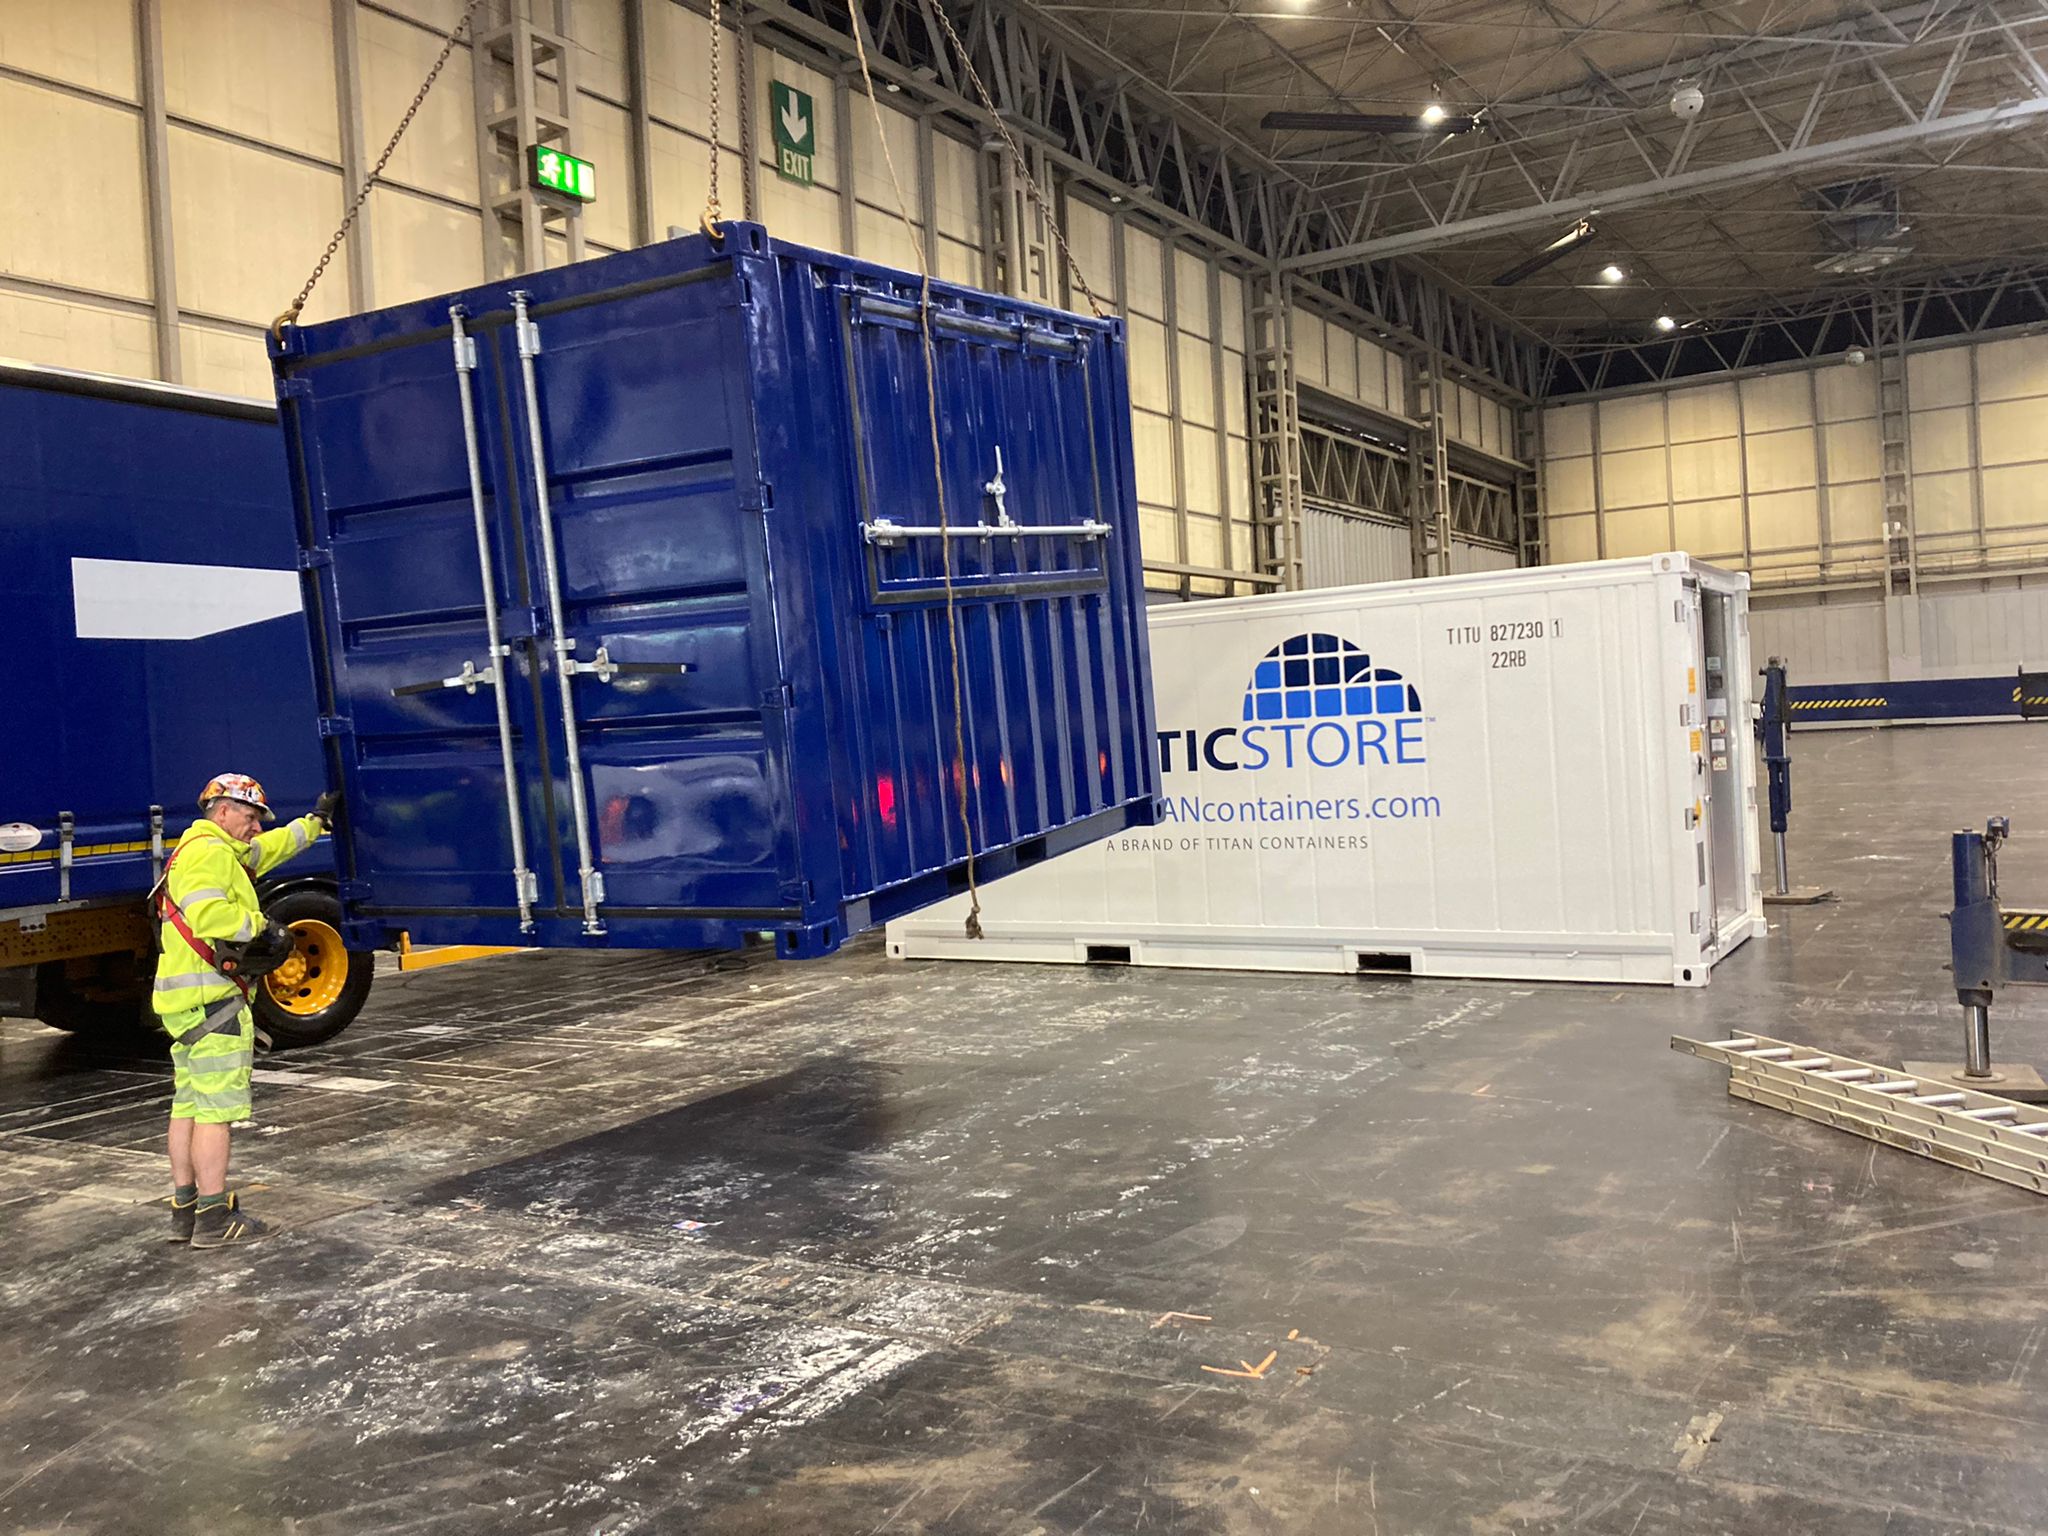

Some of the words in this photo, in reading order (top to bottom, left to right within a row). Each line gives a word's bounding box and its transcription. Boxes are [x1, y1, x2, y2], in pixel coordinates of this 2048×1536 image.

[783, 148, 809, 180] EXIT
[1447, 627, 1481, 645] TITU
[1490, 621, 1543, 642] 827230
[1553, 619, 1561, 637] 1
[1491, 650, 1527, 668] 22RB
[1106, 840, 1115, 851] A
[1122, 838, 1173, 851] BRAND
[1180, 838, 1200, 850] OF
[1206, 837, 1253, 850] TITAN
[1259, 836, 1369, 850] CONTAINERS
